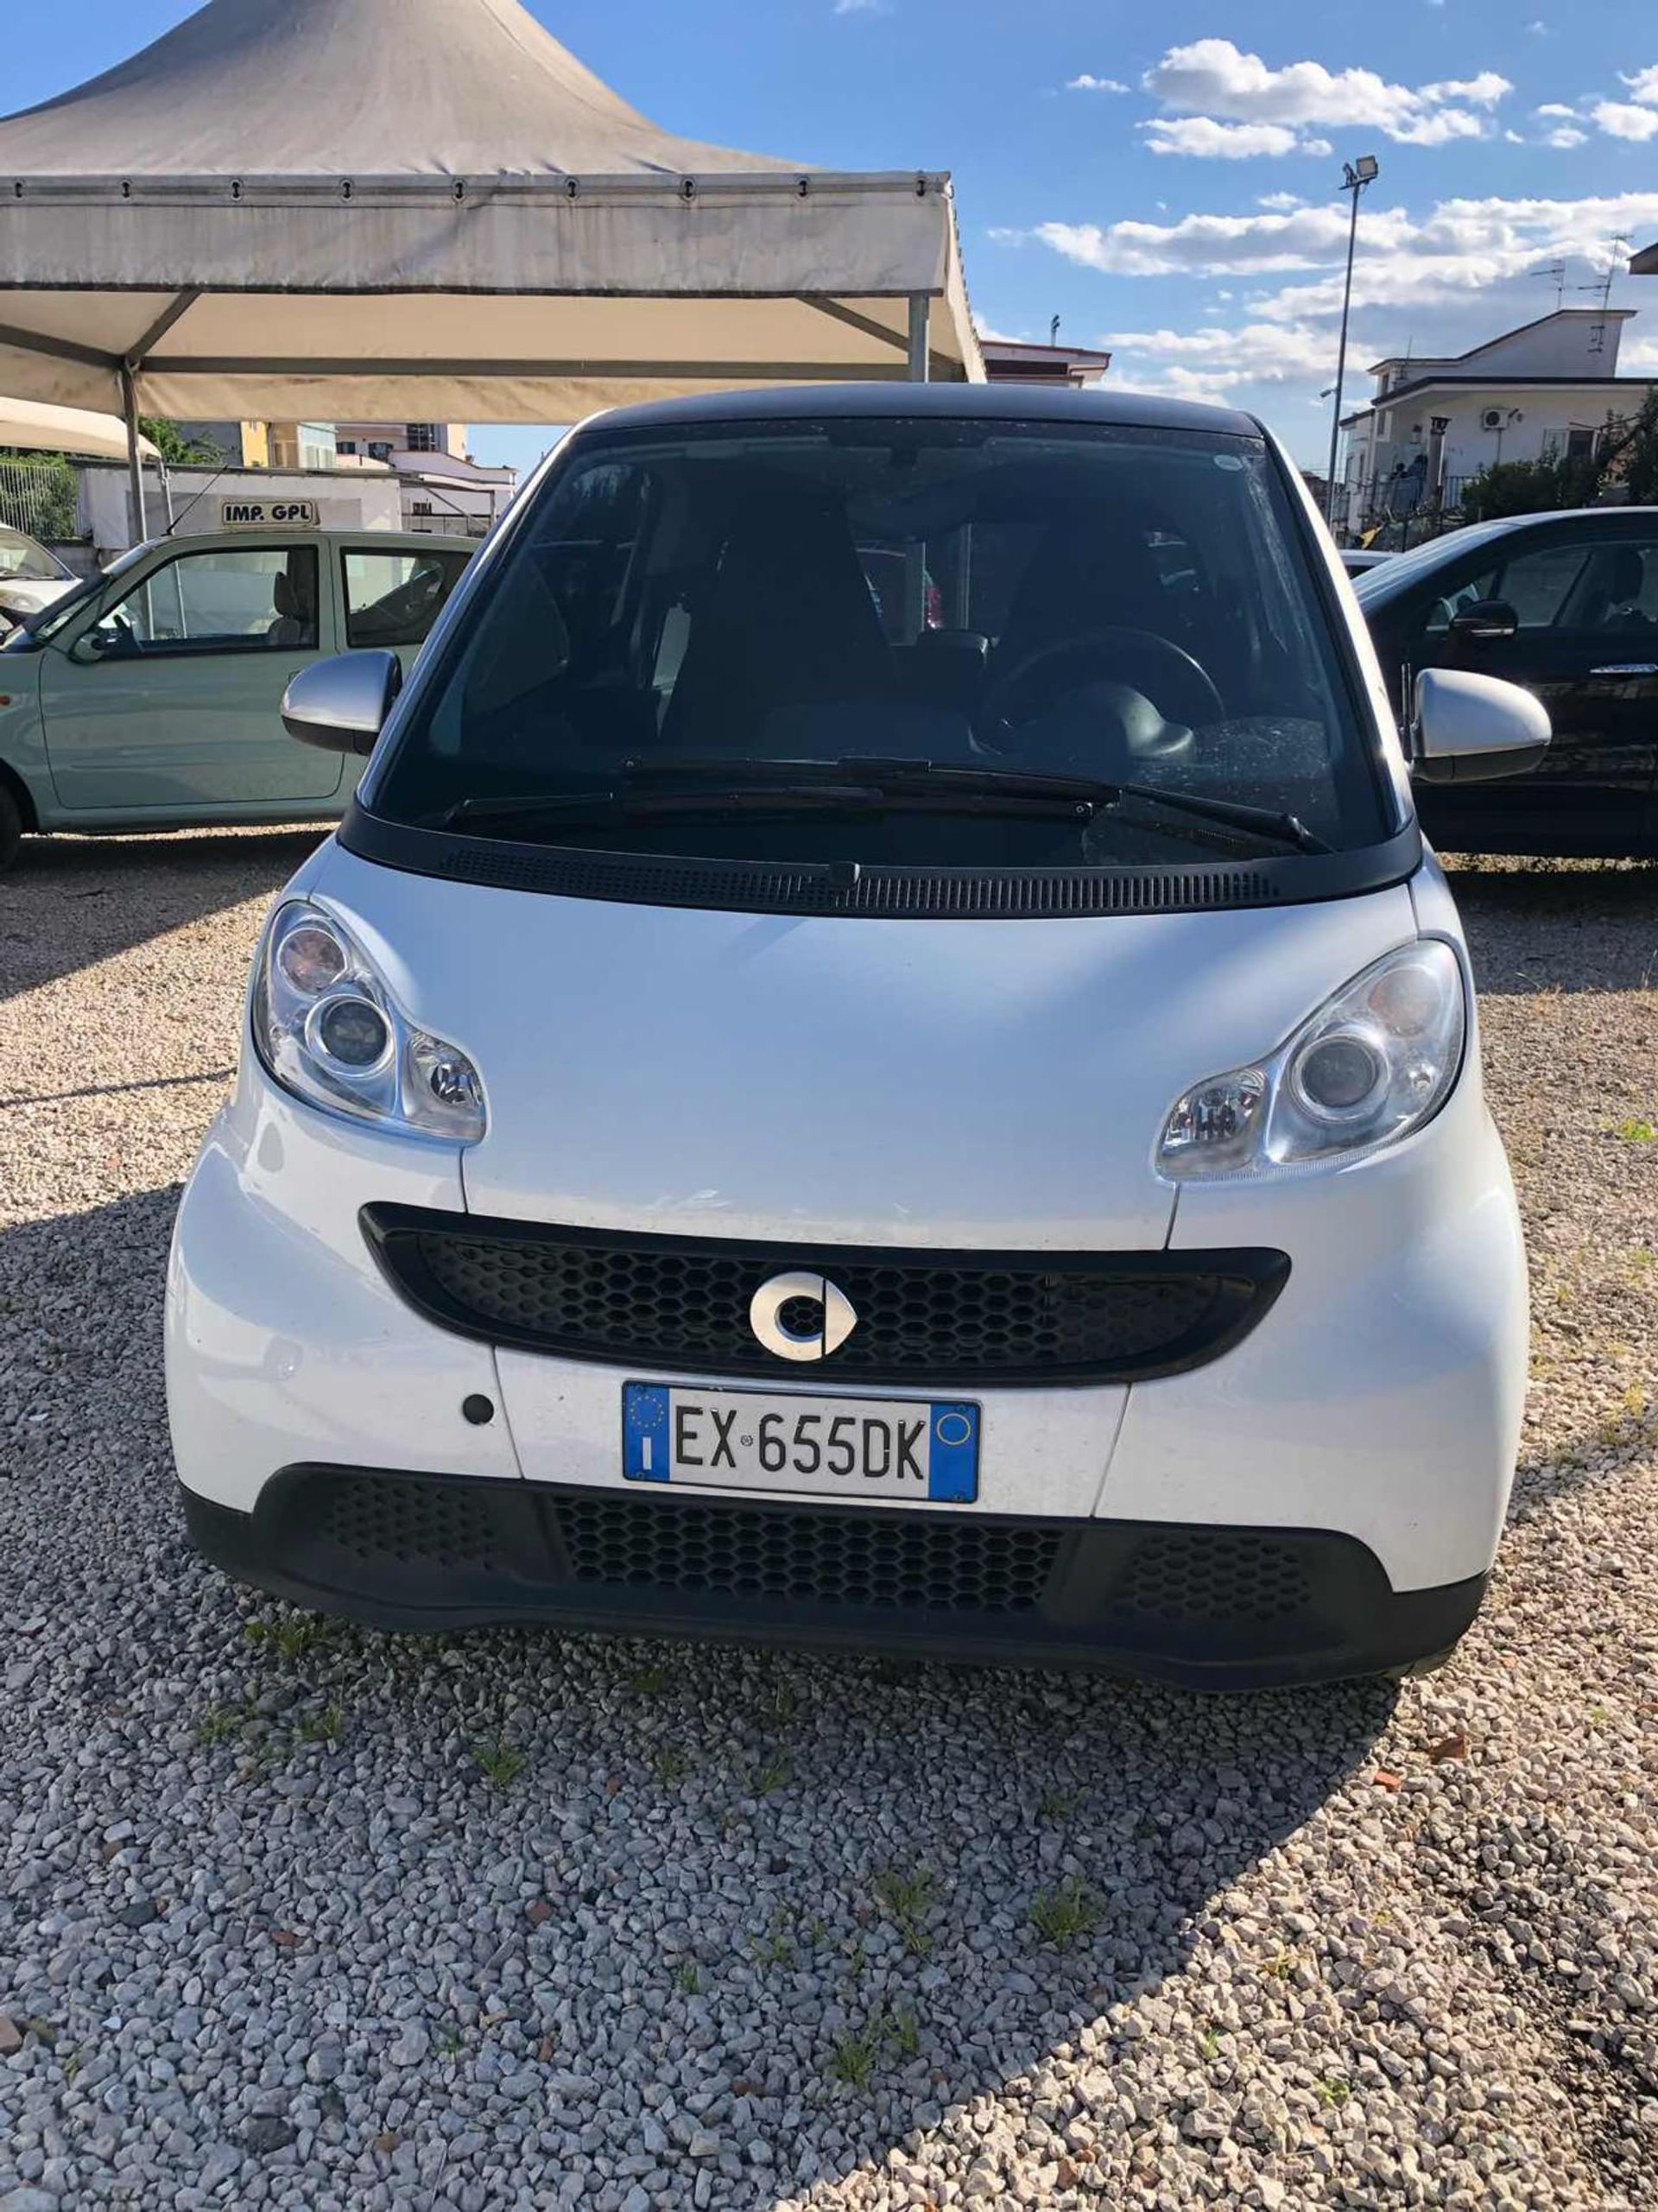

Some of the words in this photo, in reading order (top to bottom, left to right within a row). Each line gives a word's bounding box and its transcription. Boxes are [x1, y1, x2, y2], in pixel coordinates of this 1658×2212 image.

[225, 504, 264, 521] IMP.
[271, 504, 310, 520] GPL
[642, 1436, 653, 1470] I
[675, 1405, 737, 1468] EX
[758, 1413, 927, 1480] 655DK
